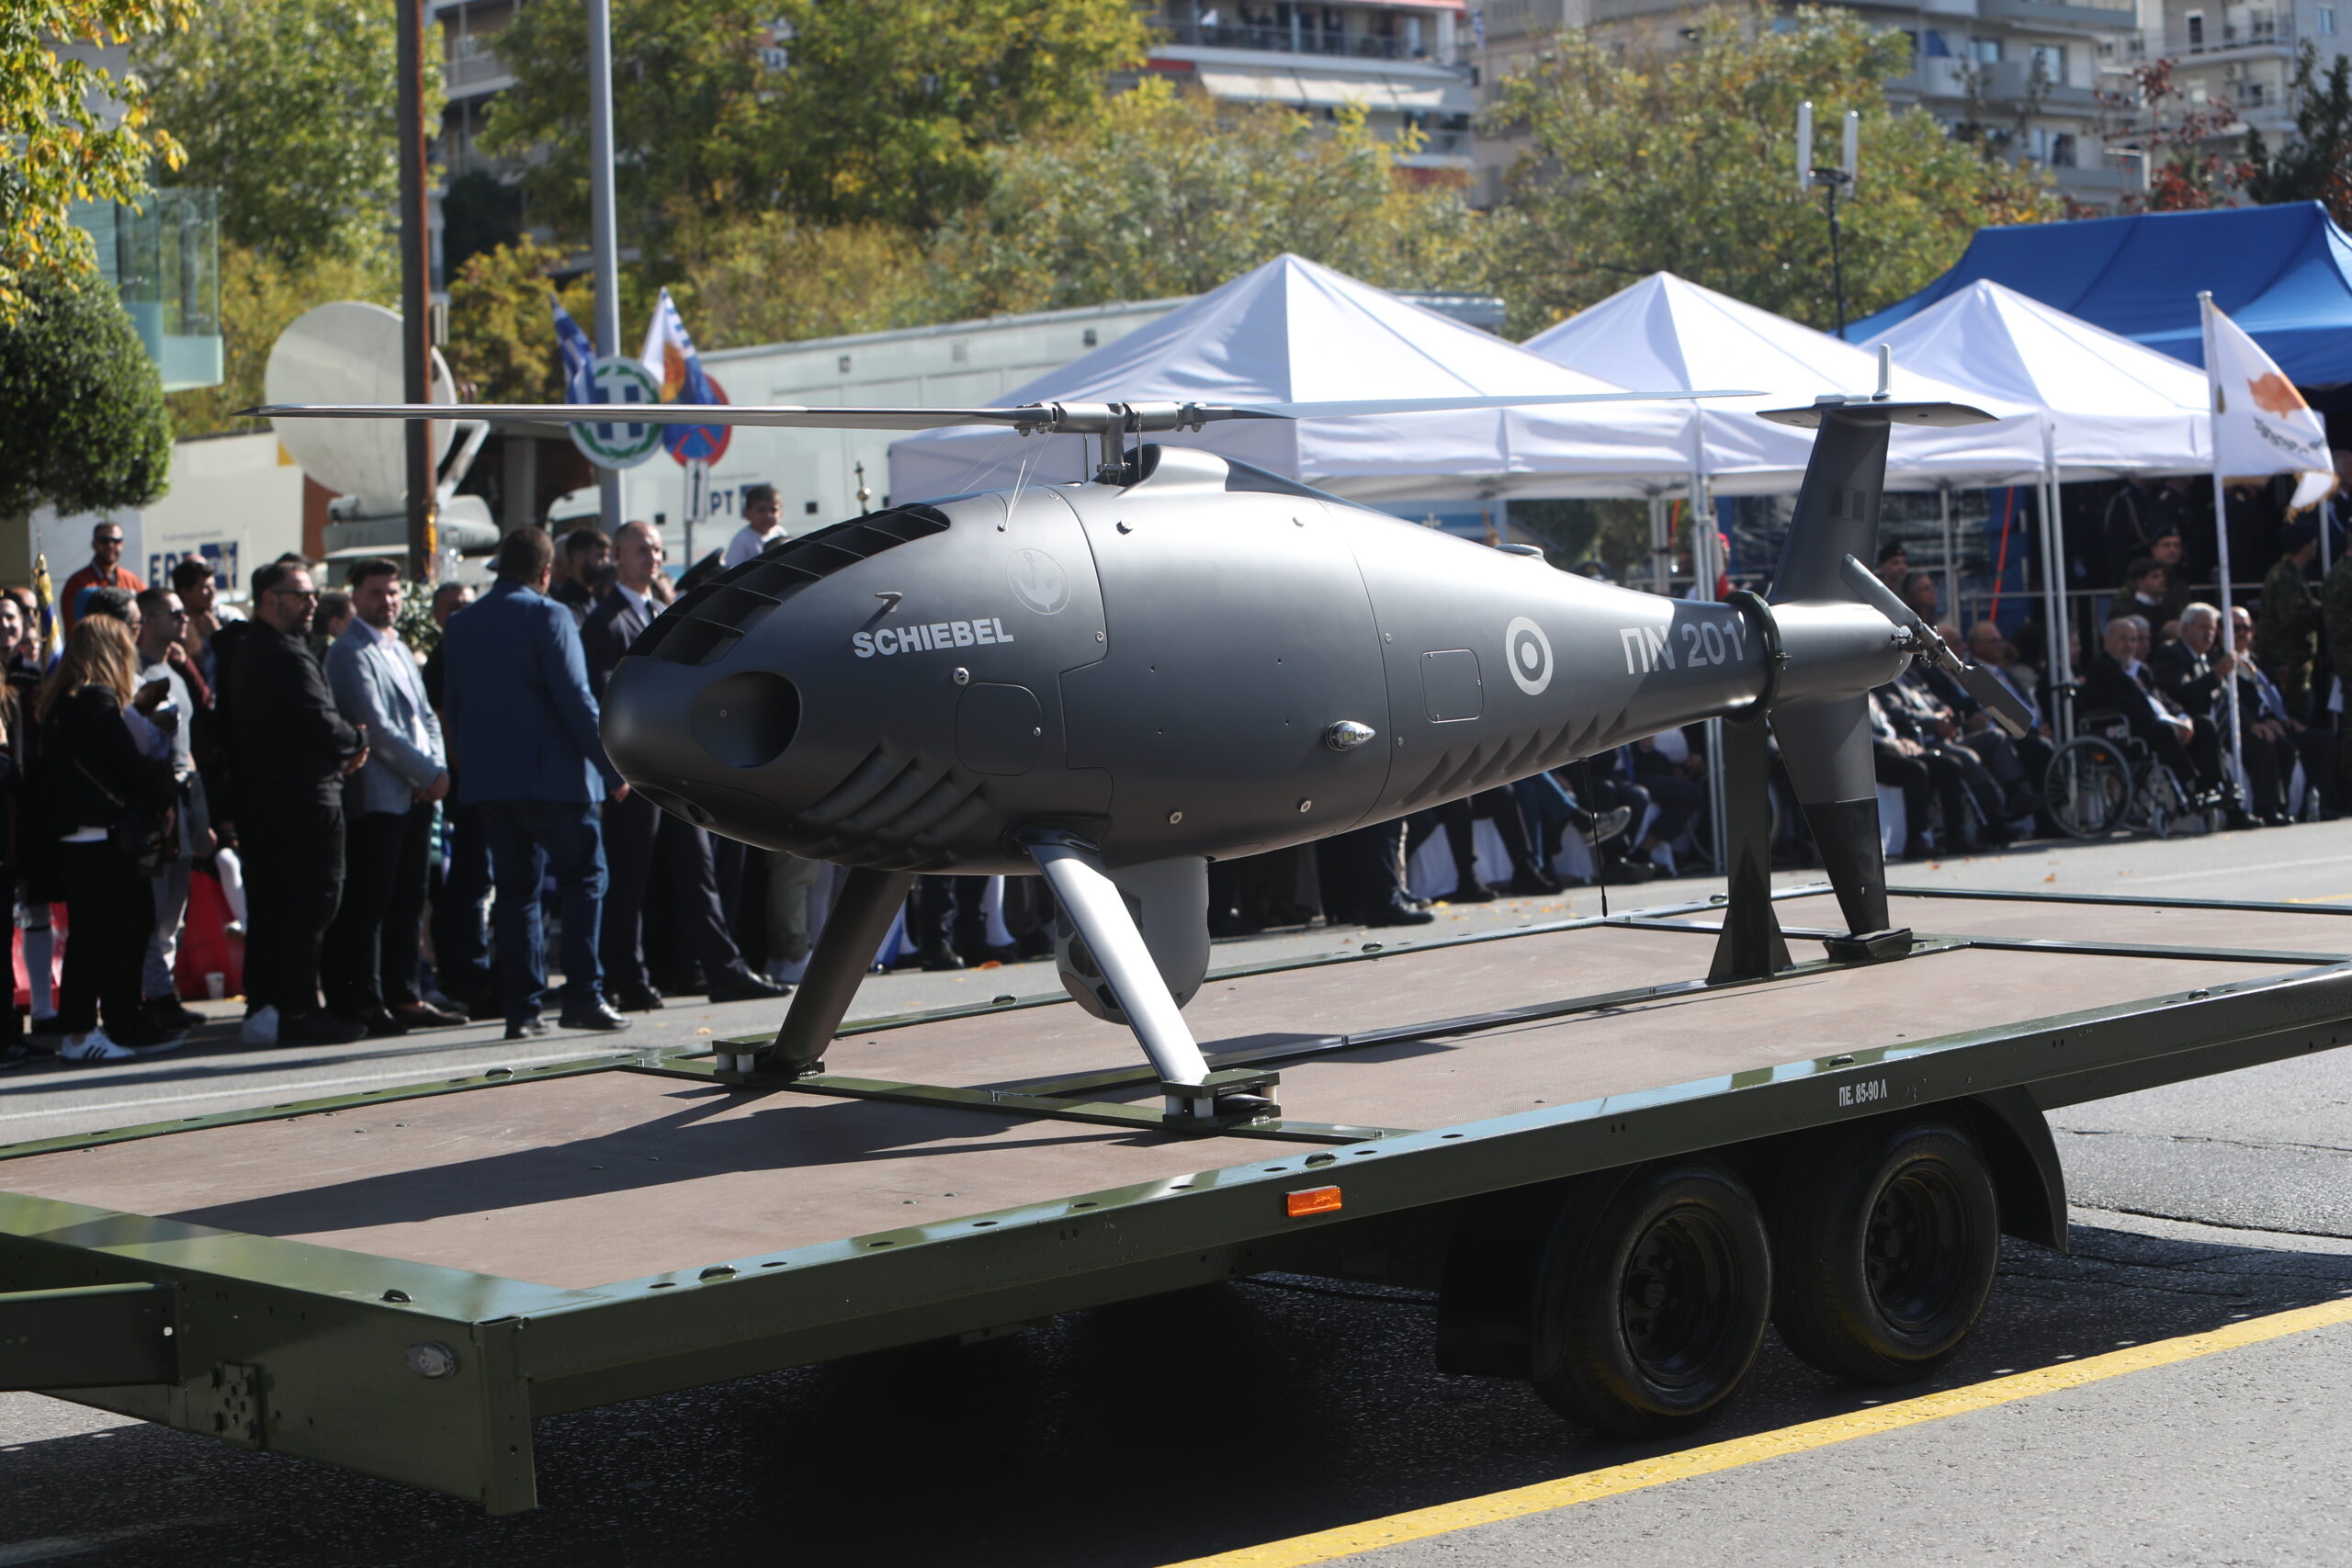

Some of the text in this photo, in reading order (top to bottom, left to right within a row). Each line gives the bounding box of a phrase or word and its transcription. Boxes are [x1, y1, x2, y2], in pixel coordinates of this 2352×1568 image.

[707, 490, 733, 516] ΡΤ
[150, 551, 193, 590] ΕΡ
[852, 617, 1014, 659] SCHIEBEL
[1619, 619, 1744, 675] ΠΝ 201
[1856, 1079, 1879, 1104] 85-90
